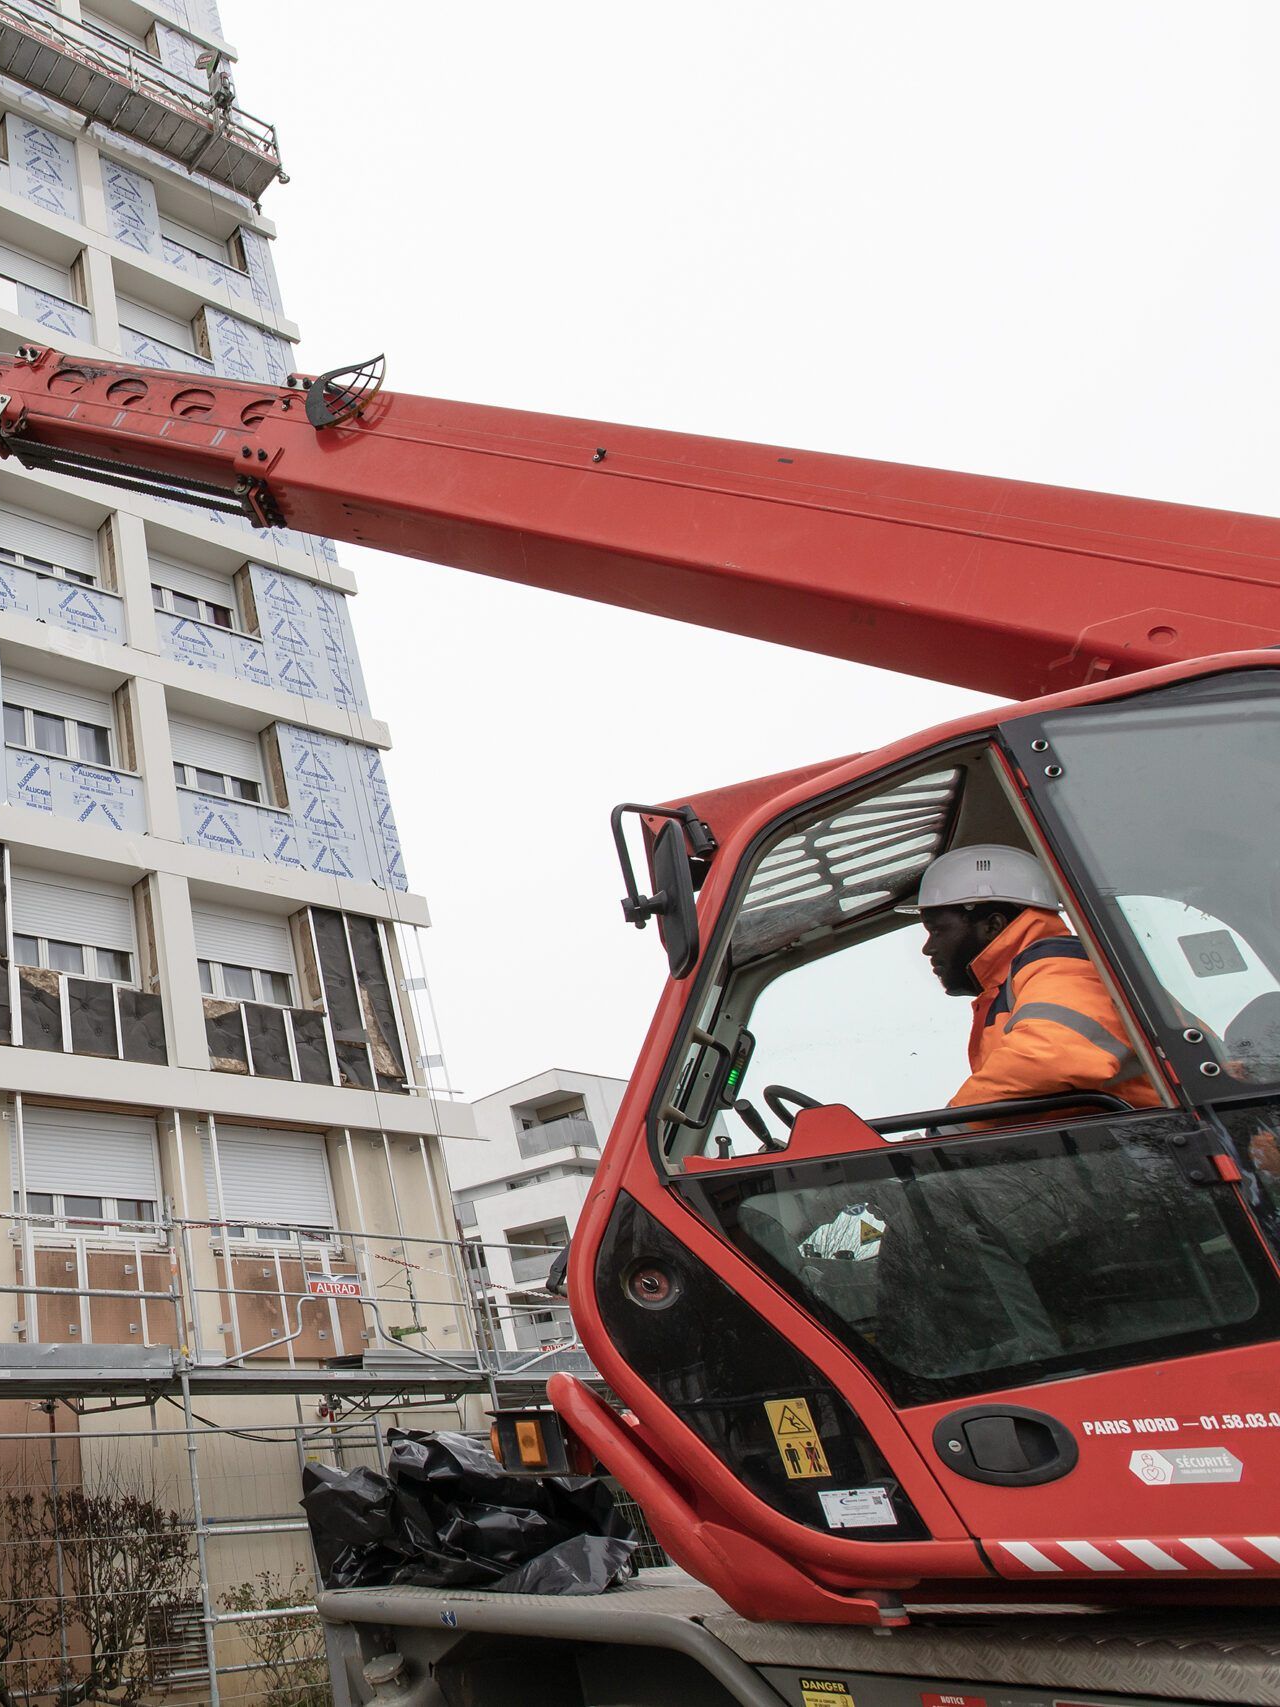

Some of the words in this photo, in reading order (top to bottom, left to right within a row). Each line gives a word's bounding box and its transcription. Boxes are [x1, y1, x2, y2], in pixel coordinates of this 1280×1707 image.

[18, 764, 41, 789] ALUCOBOND
[78, 769, 112, 782] ALUCOBOND
[197, 812, 214, 837] ALUCOBOND
[218, 815, 242, 846] ALUCOBOND
[204, 834, 235, 845] ALUCOBOND
[317, 1282, 356, 1294] ALTRAD
[1083, 1420, 1131, 1435] PARIS
[1133, 1417, 1180, 1433] NORD
[1176, 1454, 1232, 1468] SÉCURITÉ
[801, 1680, 847, 1693] DANGER
[940, 1695, 966, 1705] NOTICE
